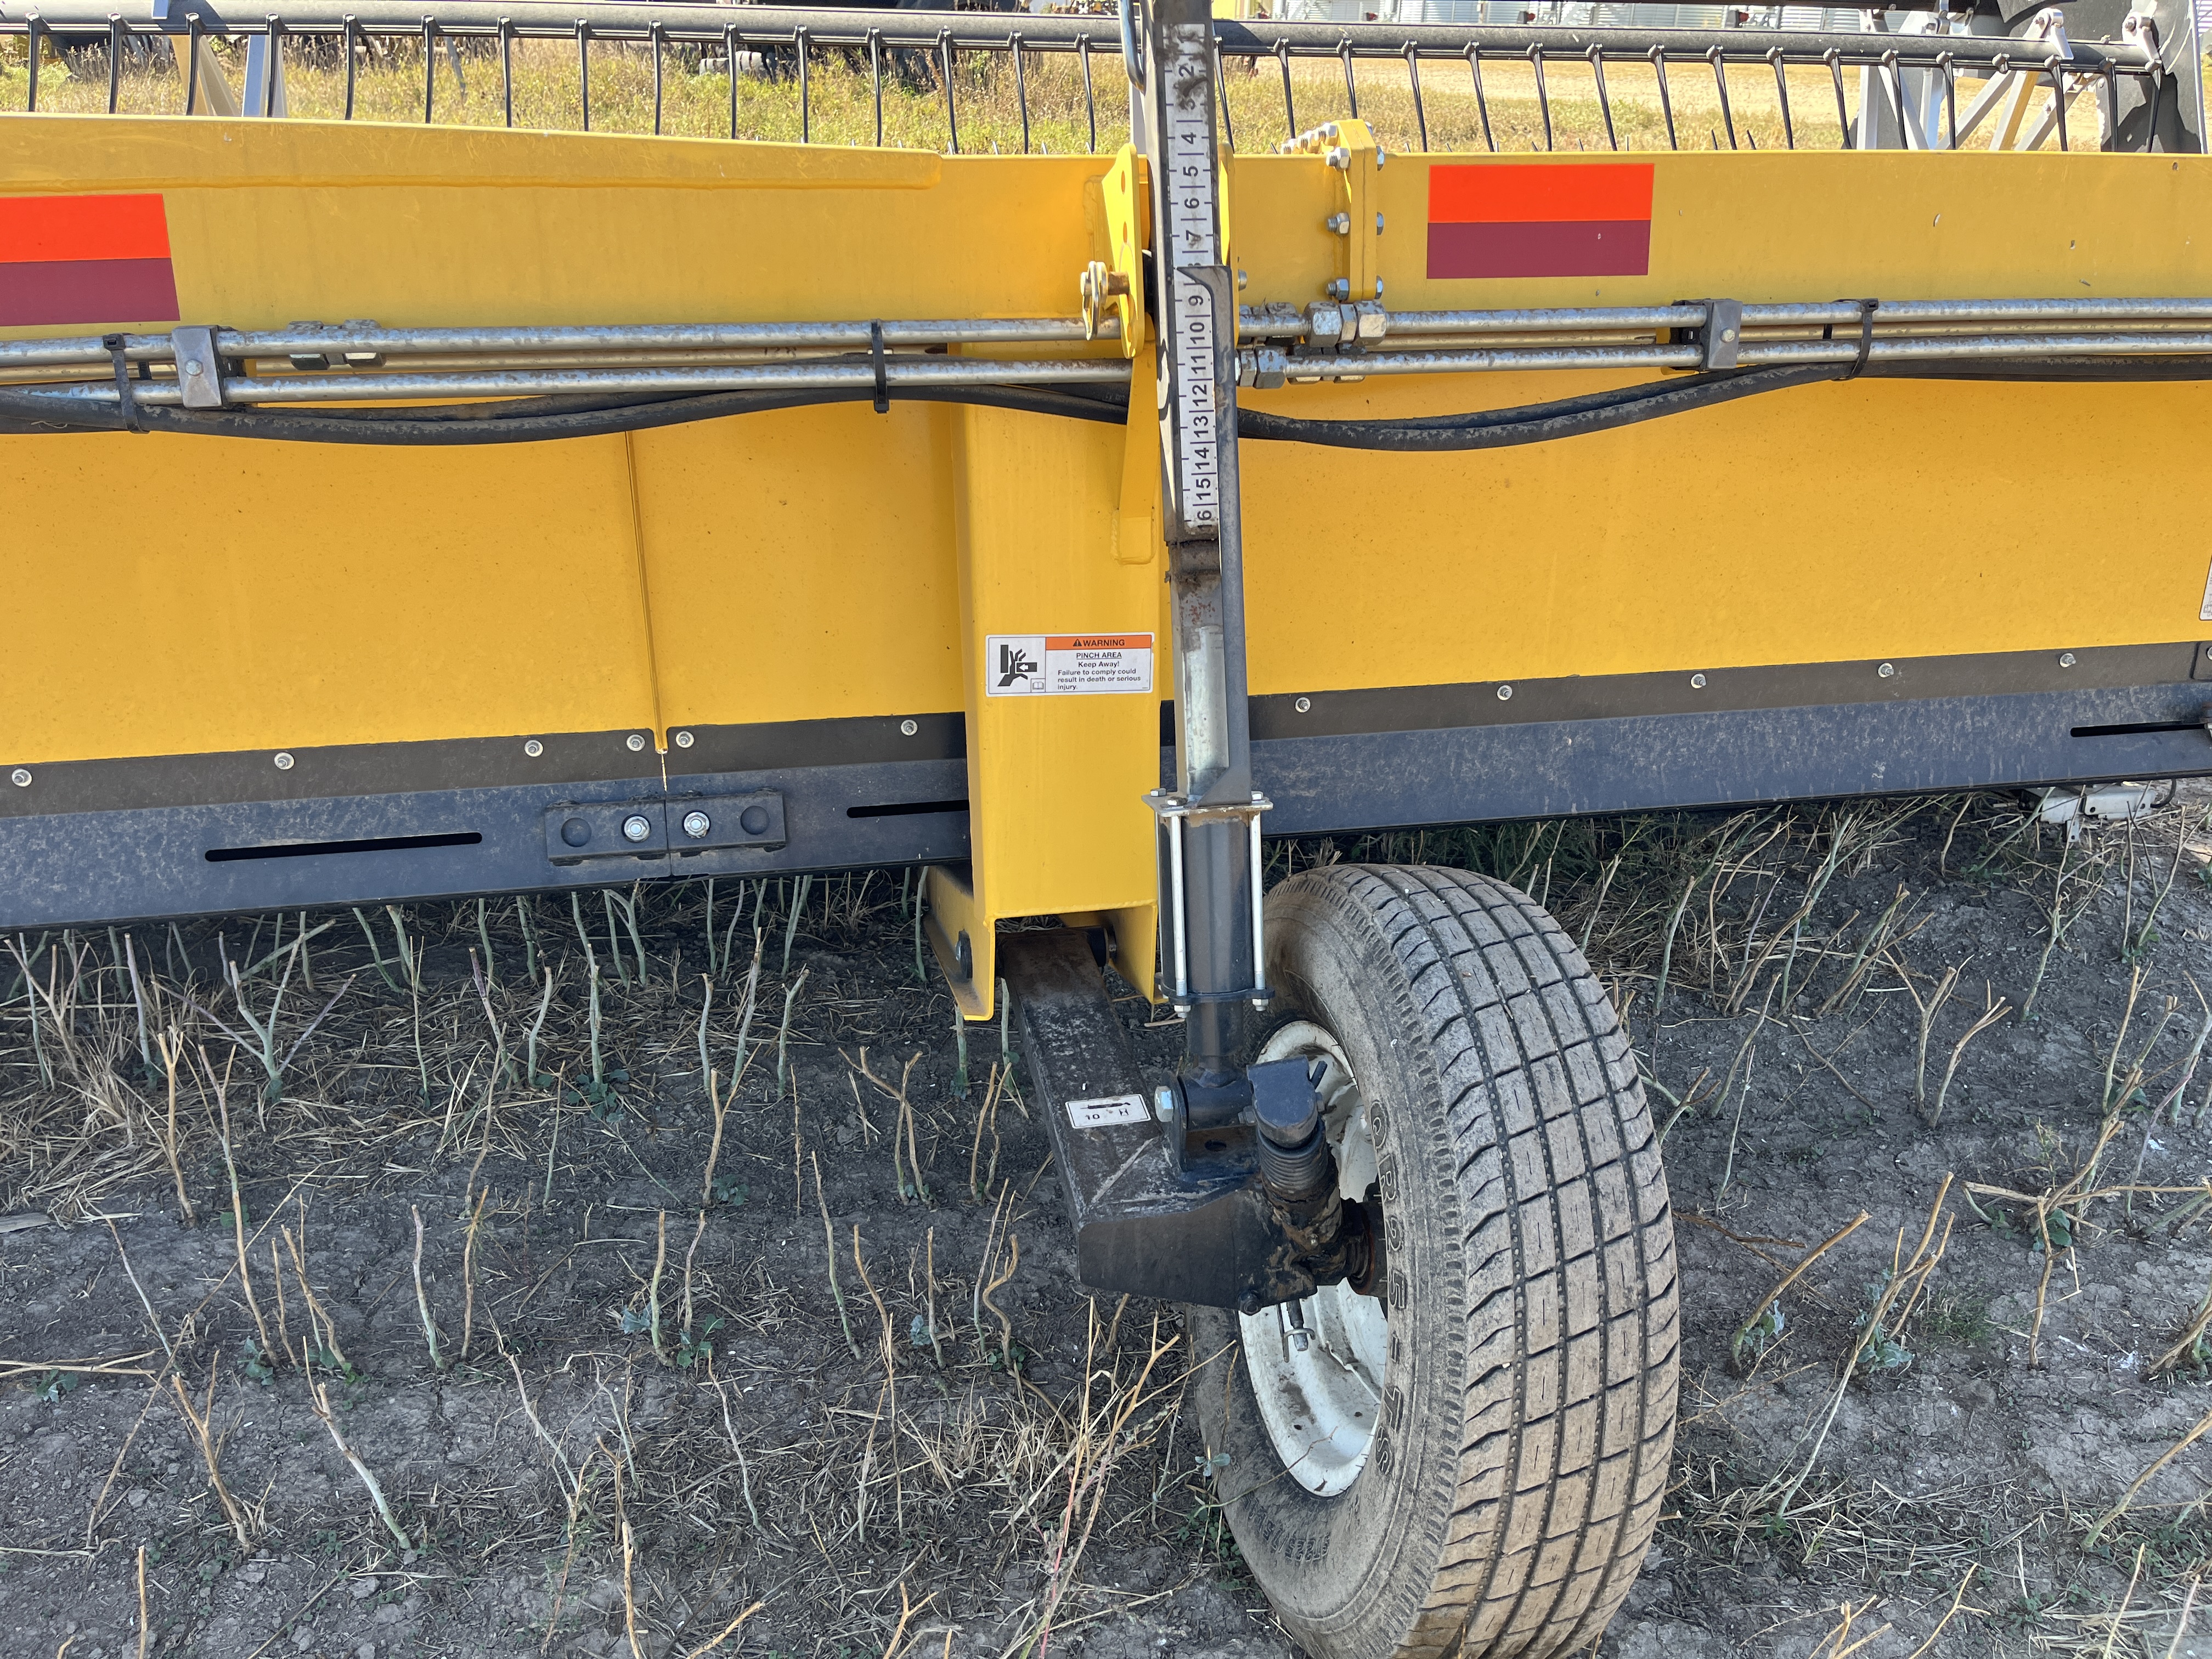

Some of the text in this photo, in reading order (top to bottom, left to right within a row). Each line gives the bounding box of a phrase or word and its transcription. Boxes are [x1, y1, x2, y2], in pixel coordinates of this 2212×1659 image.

[1178, 65, 1194, 77] 2
[1181, 132, 1197, 145] 4
[1183, 166, 1199, 177] 5
[1184, 198, 1200, 209] 6
[1186, 229, 1201, 240] 7
[1188, 295, 1204, 306] 9
[1189, 322, 1205, 345] 10
[1190, 356, 1206, 374] 11
[1192, 385, 1207, 407] 12
[1193, 416, 1209, 438] 13
[1194, 447, 1210, 470] 14
[1196, 478, 1211, 500] 15
